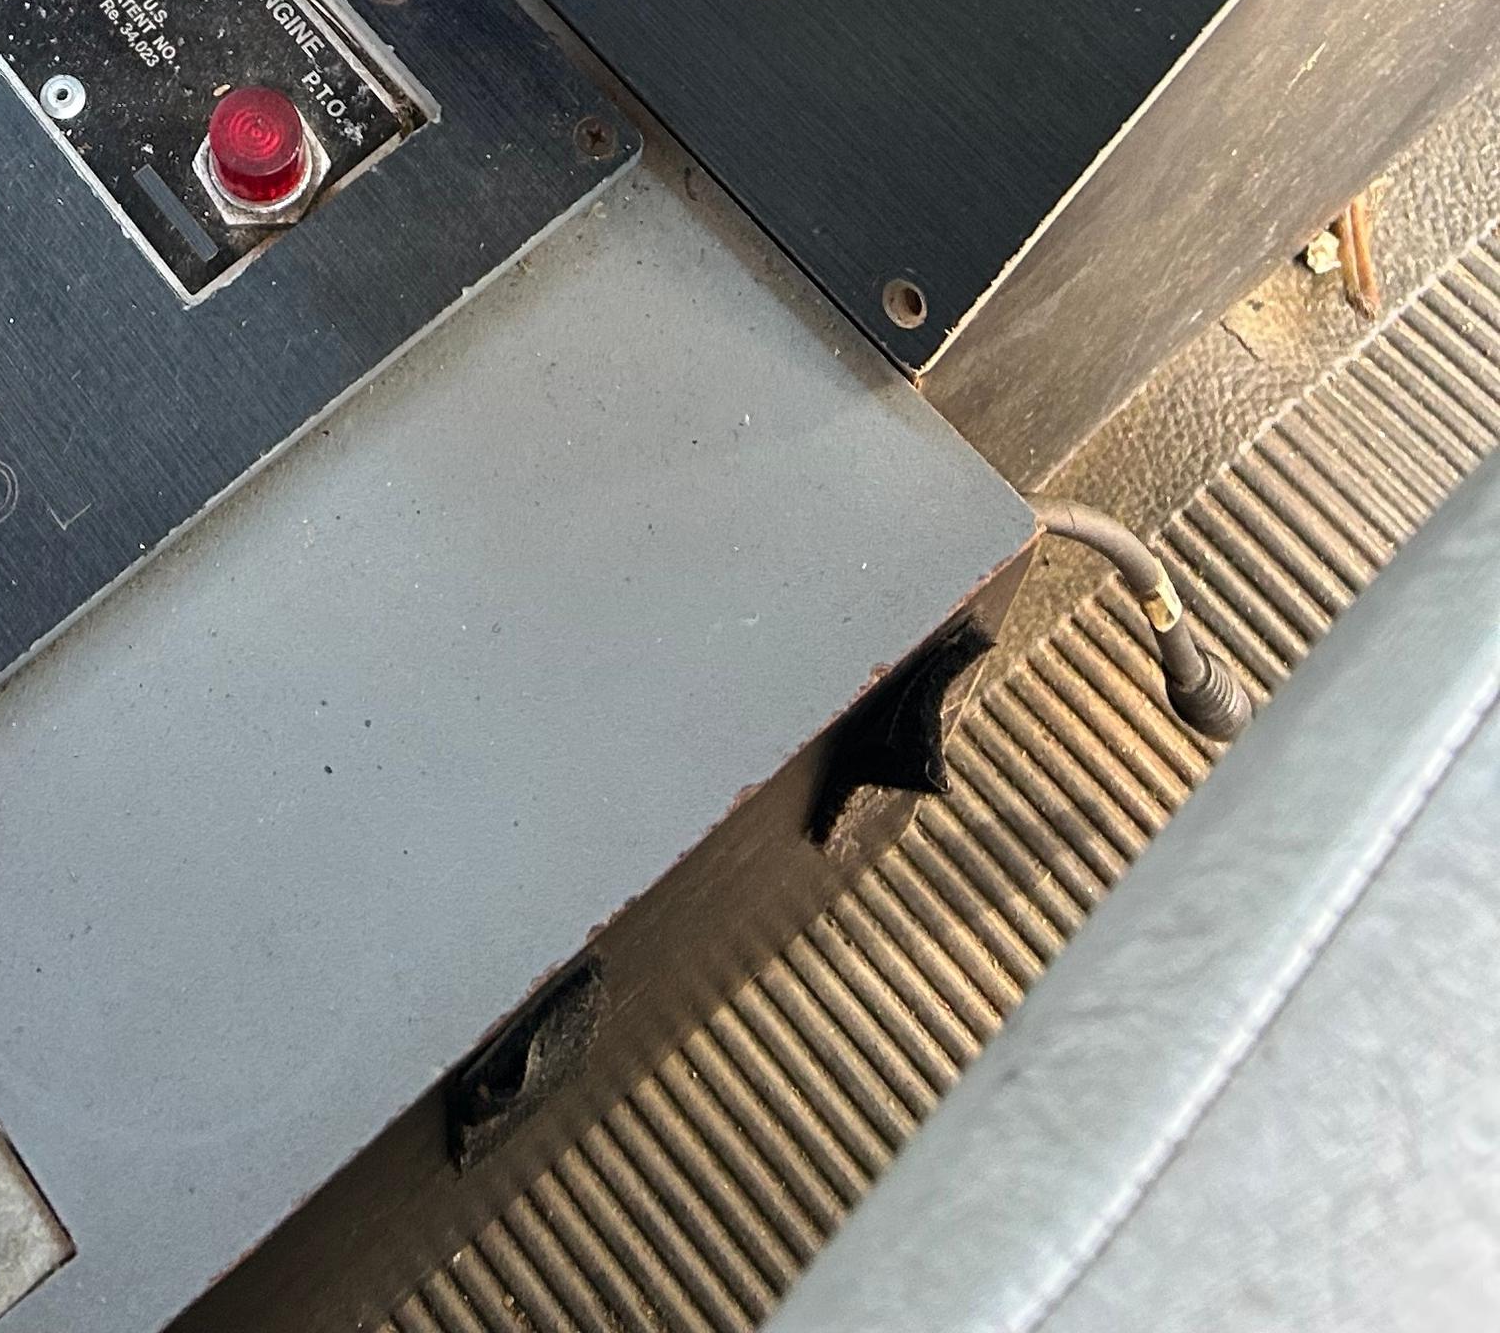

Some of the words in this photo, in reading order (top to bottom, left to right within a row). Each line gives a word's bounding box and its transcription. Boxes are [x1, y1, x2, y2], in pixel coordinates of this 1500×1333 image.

[120, 23, 159, 67] 34,023
[153, 36, 175, 64] NO.
[302, 70, 346, 123] P.T.O.
